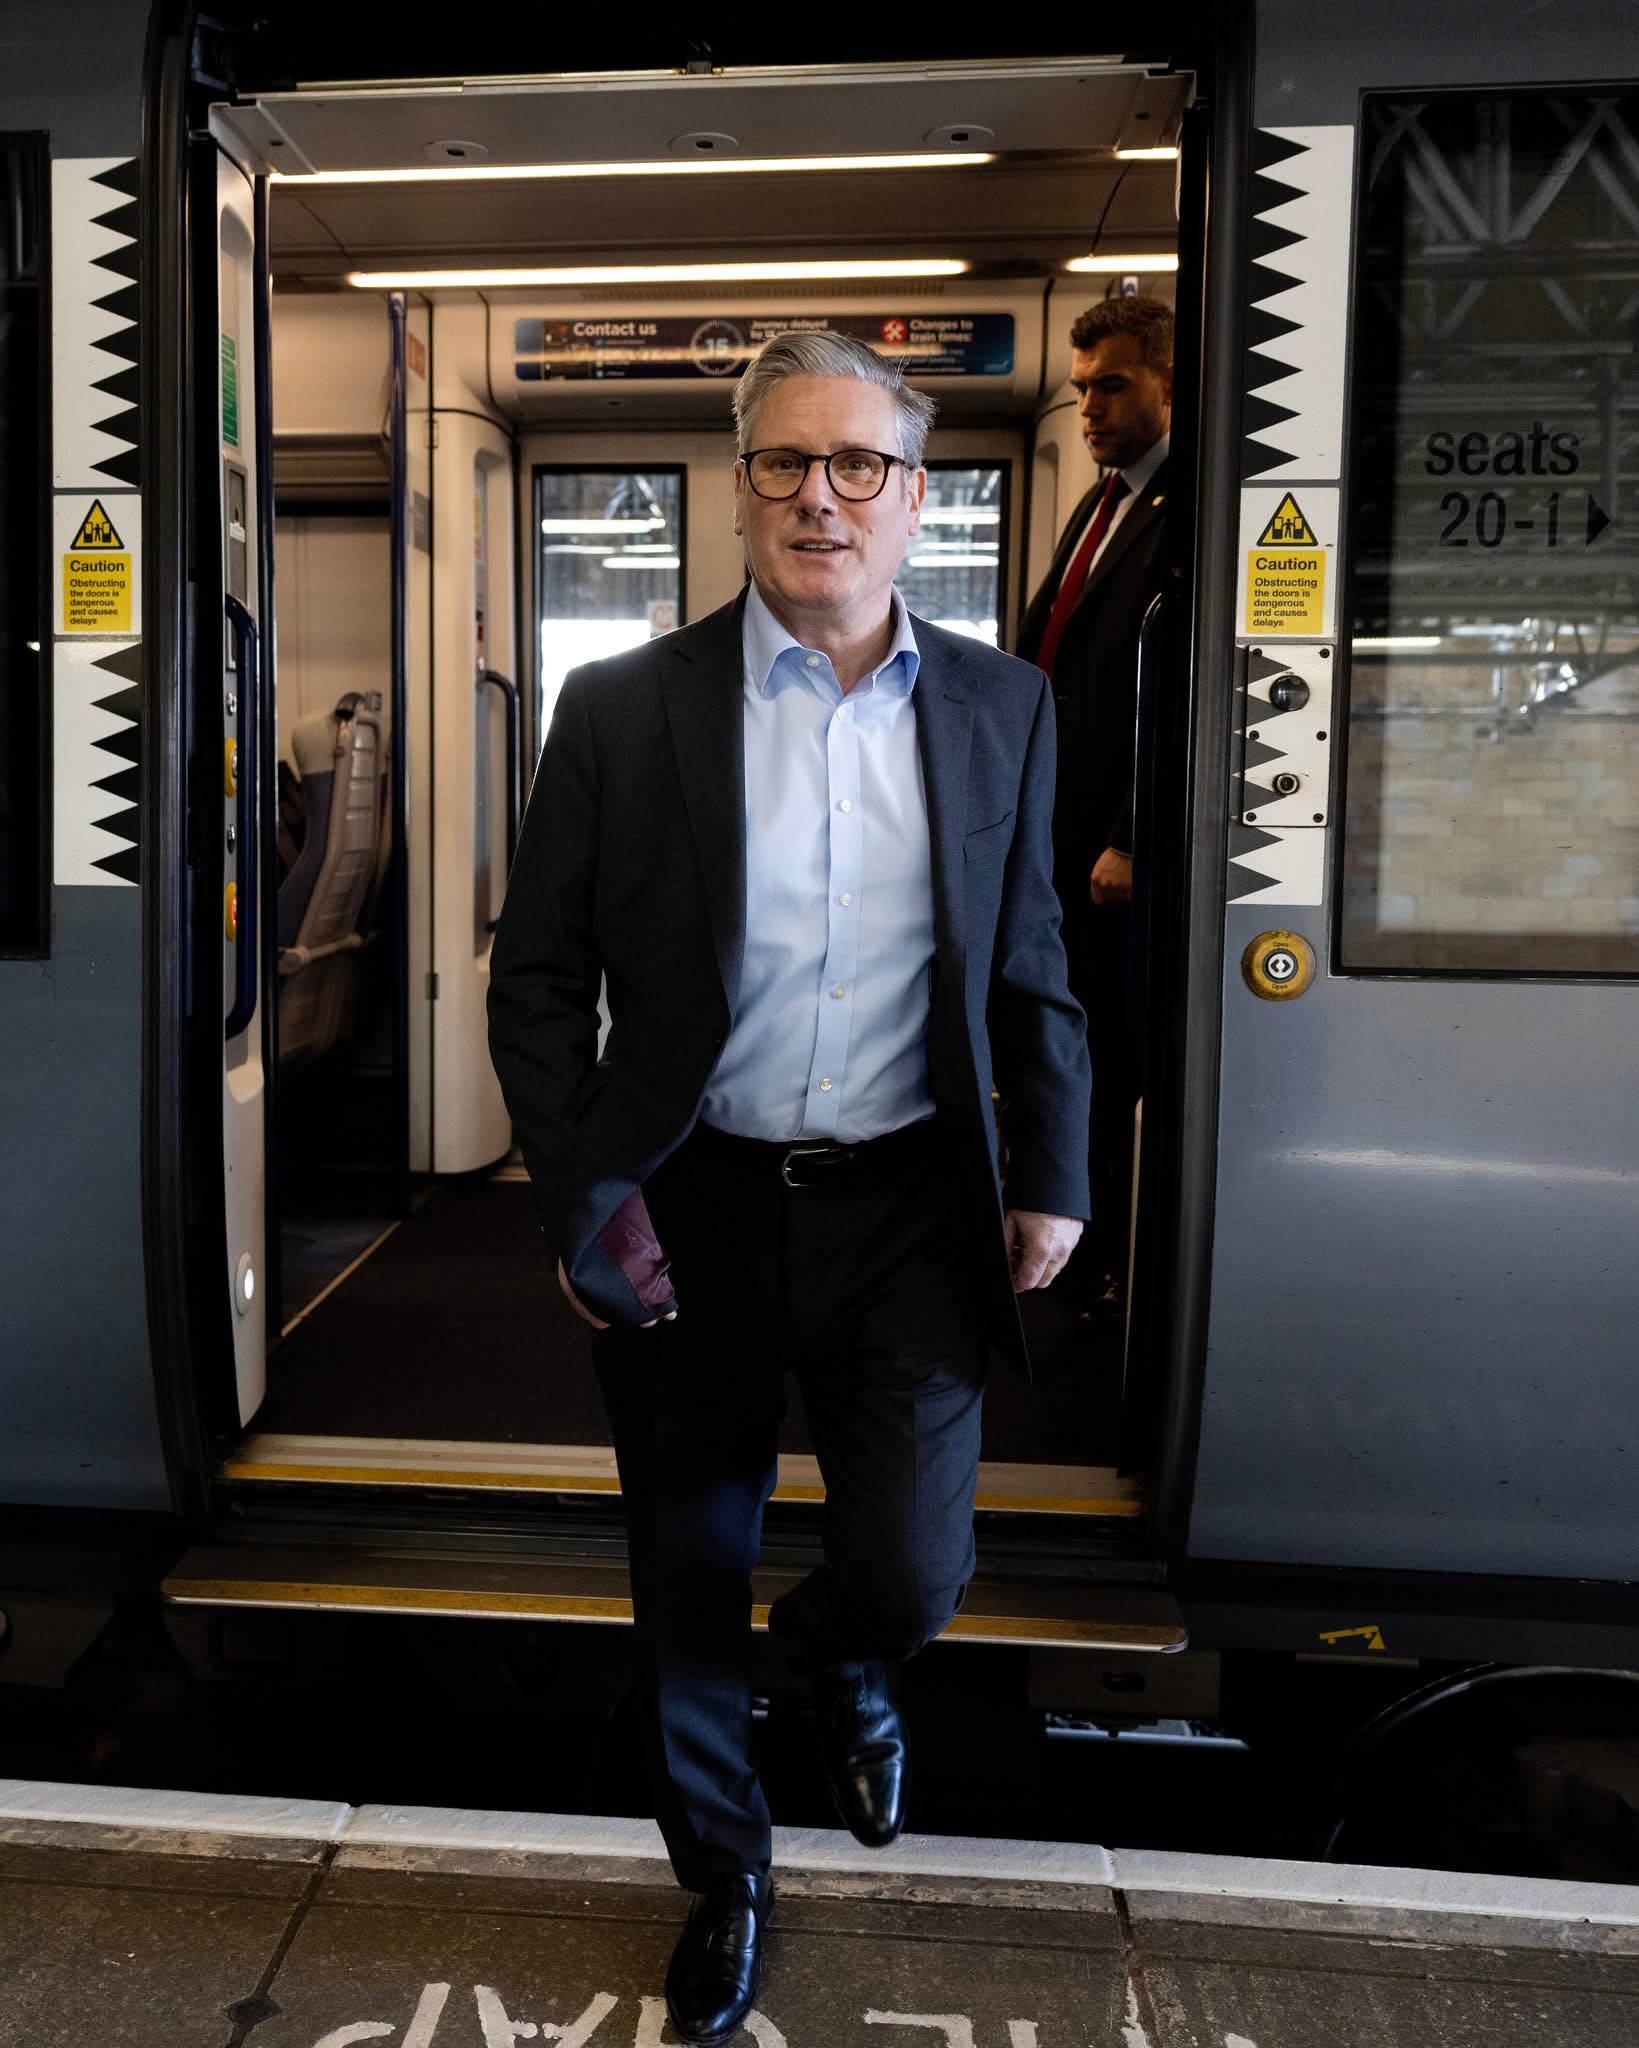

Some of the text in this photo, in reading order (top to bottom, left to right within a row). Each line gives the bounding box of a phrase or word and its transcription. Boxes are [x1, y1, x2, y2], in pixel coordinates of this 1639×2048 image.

[573, 321, 657, 336] Contact us
[909, 319, 974, 331] Changes to
[909, 332, 937, 343] train
[1424, 420, 1580, 476] seats
[70, 560, 125, 572] Caution
[1256, 557, 1317, 570] Caution
[70, 578, 126, 589] Obstructing
[1254, 577, 1318, 588] Obstructing
[70, 590, 120, 598] the doors is
[1254, 589, 1311, 598] the doors is
[70, 599, 115, 608] dangerous
[1253, 599, 1305, 608] dangerous
[70, 608, 87, 616] and
[1253, 609, 1272, 617] and
[70, 617, 97, 625] delays
[1253, 618, 1284, 627] delays
